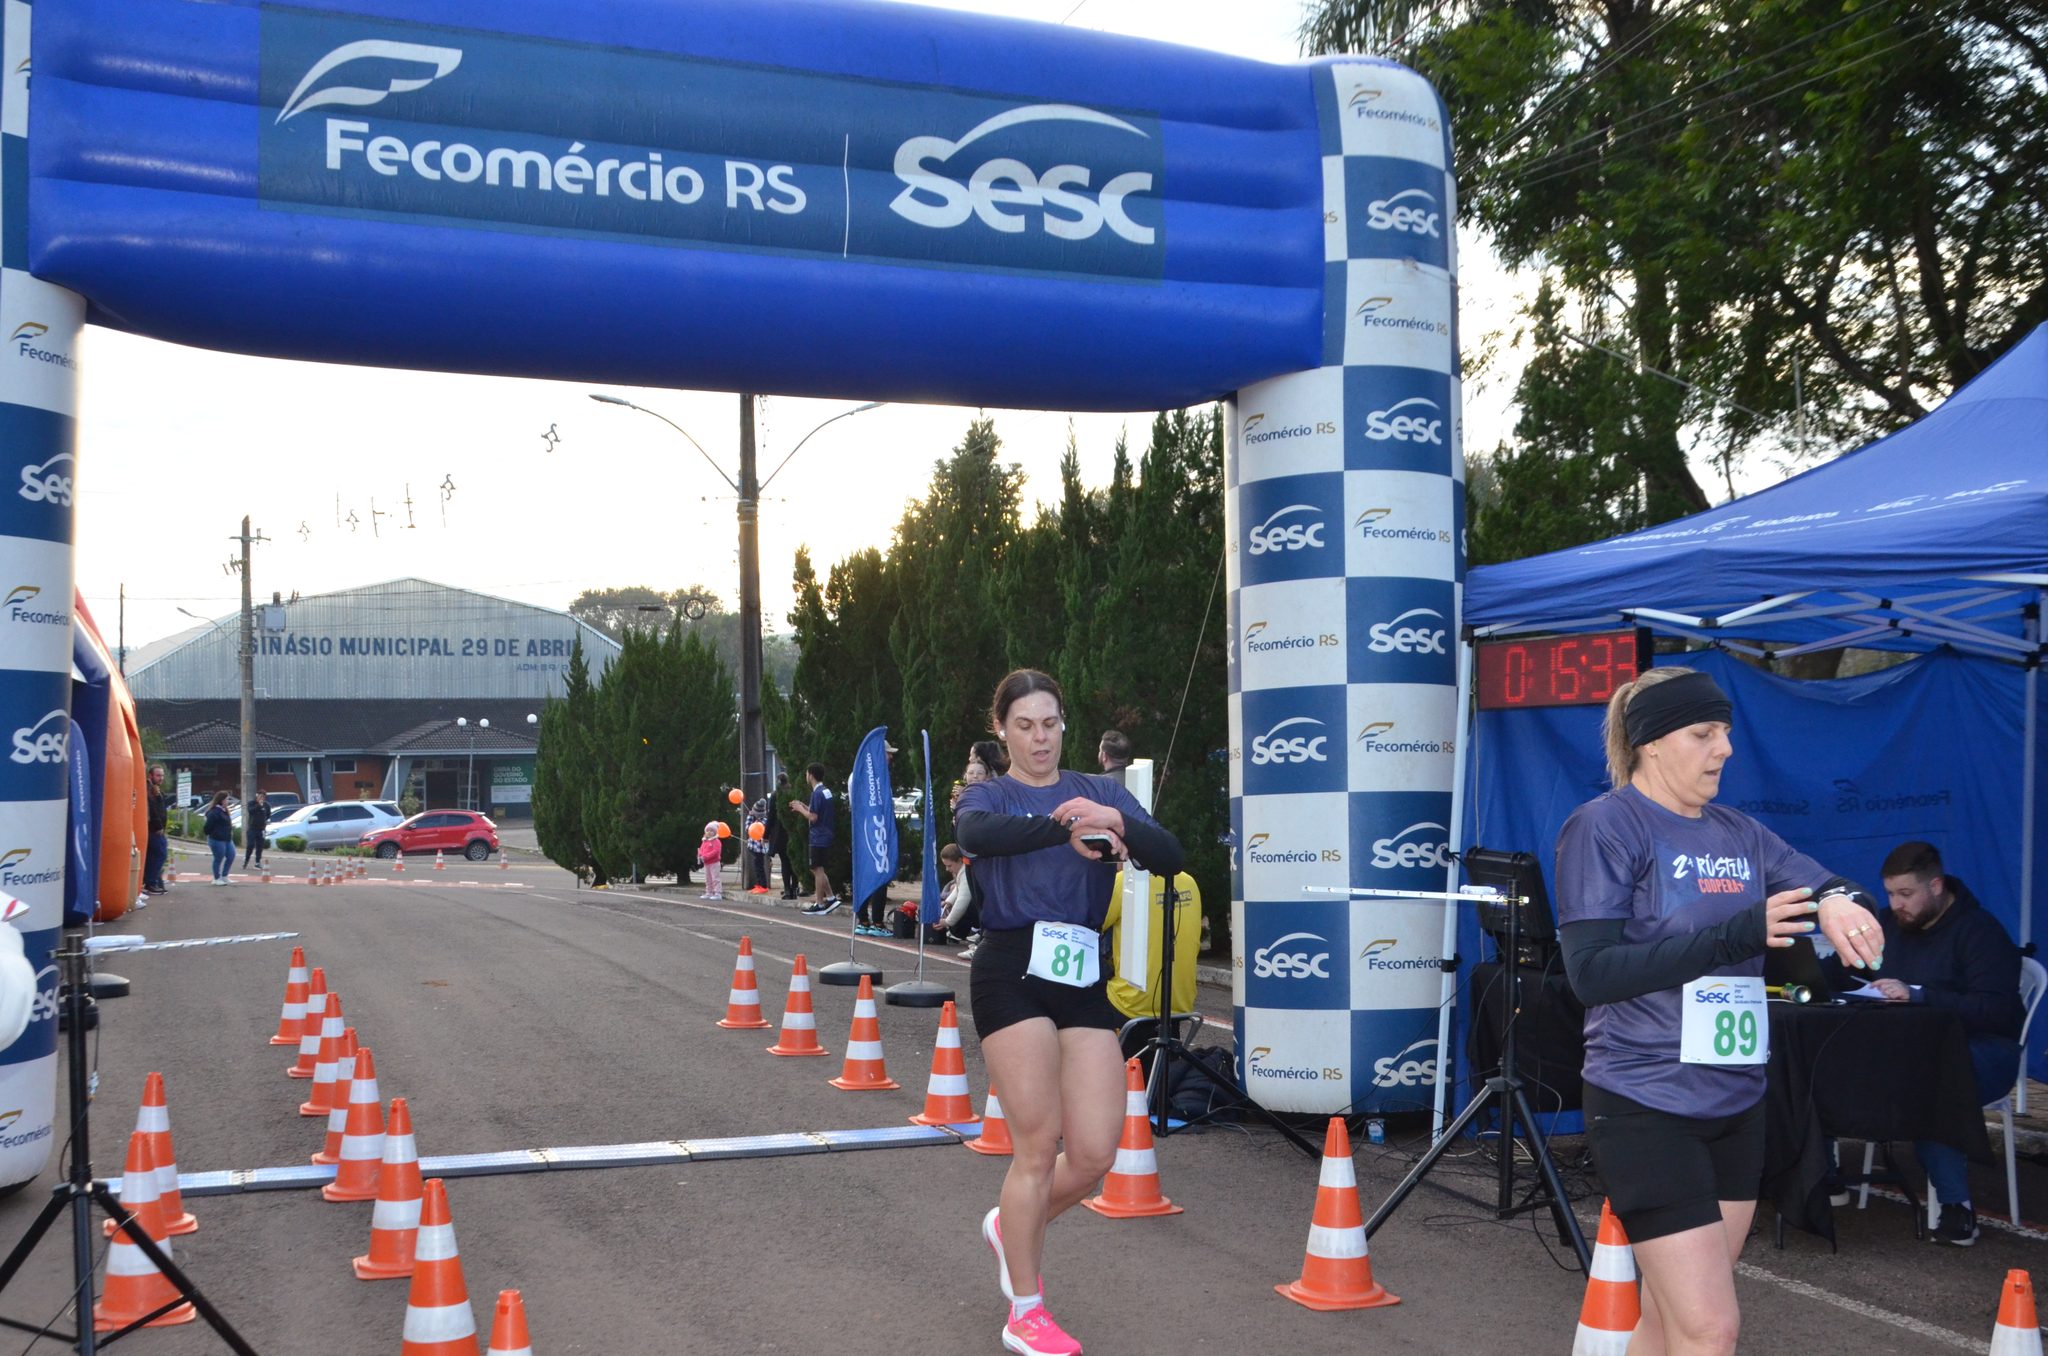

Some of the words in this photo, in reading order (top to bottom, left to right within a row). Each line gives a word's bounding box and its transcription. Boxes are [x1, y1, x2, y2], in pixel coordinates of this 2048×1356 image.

[1356, 106, 1426, 127] Fecomércio
[325, 118, 704, 205] Fecomércio
[725, 159, 807, 214] RS
[889, 135, 1155, 245] Sesc
[1366, 199, 1440, 238] Sesc
[1363, 314, 1435, 333] Fecomércio
[1436, 321, 1449, 336] RS
[1245, 424, 1312, 446] Fecomércio
[1316, 421, 1337, 435] RS
[1364, 410, 1442, 445] Sesc
[1248, 521, 1325, 556] Sesc
[1363, 525, 1436, 542] Fecomércio
[1438, 529, 1451, 544] RS
[339, 636, 455, 657] MUNICIPAL
[462, 637, 488, 657] 29
[494, 638, 520, 657] DE
[1248, 635, 1315, 653] Fecomércio
[1319, 633, 1340, 647] RS
[1367, 622, 1446, 655] Sesc
[1251, 735, 1328, 765] Sesc
[1366, 740, 1440, 753] Fecomércio
[1442, 741, 1455, 754] RS
[872, 814, 890, 874] Sesc
[1250, 850, 1317, 864] Fecomércio
[1321, 849, 1342, 862] RS
[1370, 838, 1449, 869] Sesc
[1695, 853, 1751, 880] RÚSTICA
[1041, 927, 1069, 941] Sesc
[1051, 943, 1085, 981] 81
[1253, 947, 1330, 979] Sesc
[1695, 989, 1731, 1004] Sesc
[1713, 1009, 1758, 1057] 89
[1252, 1064, 1319, 1080] Fecomércio
[1323, 1067, 1343, 1081] RS
